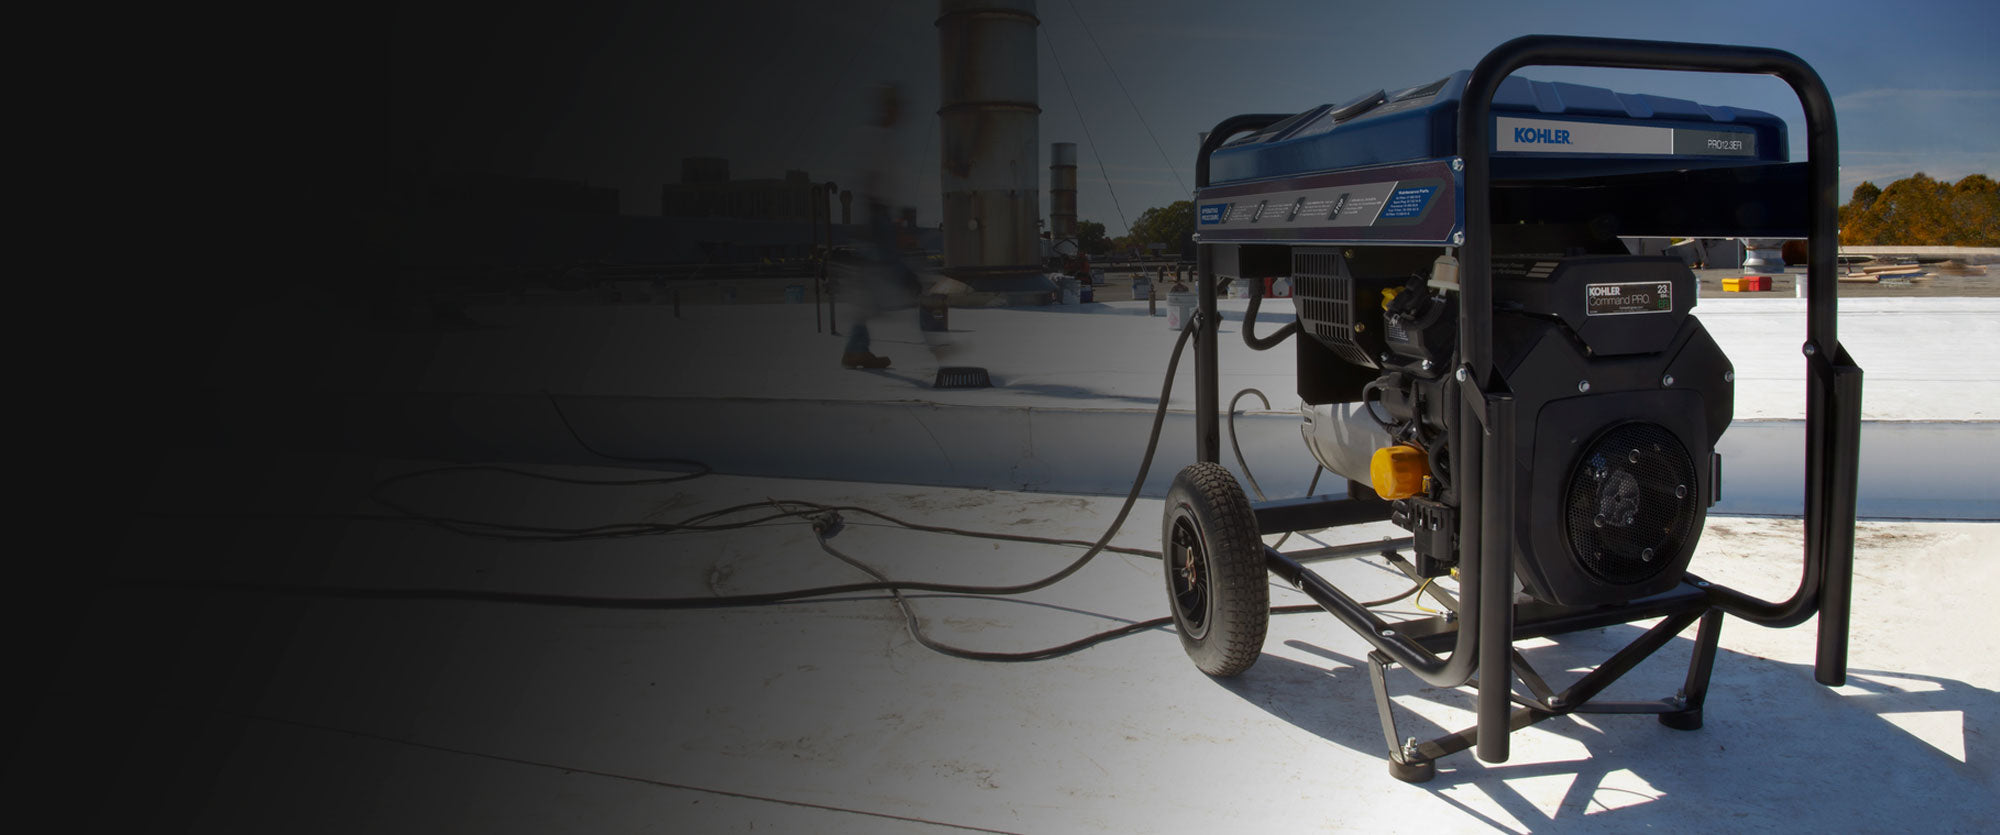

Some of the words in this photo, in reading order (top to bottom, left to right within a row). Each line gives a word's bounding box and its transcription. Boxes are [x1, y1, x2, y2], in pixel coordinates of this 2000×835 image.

[1514, 127, 1570, 144] KOHLER
[1588, 286, 1621, 296] KOHLER
[1657, 284, 1668, 294] 23
[1589, 296, 1630, 307] Command
